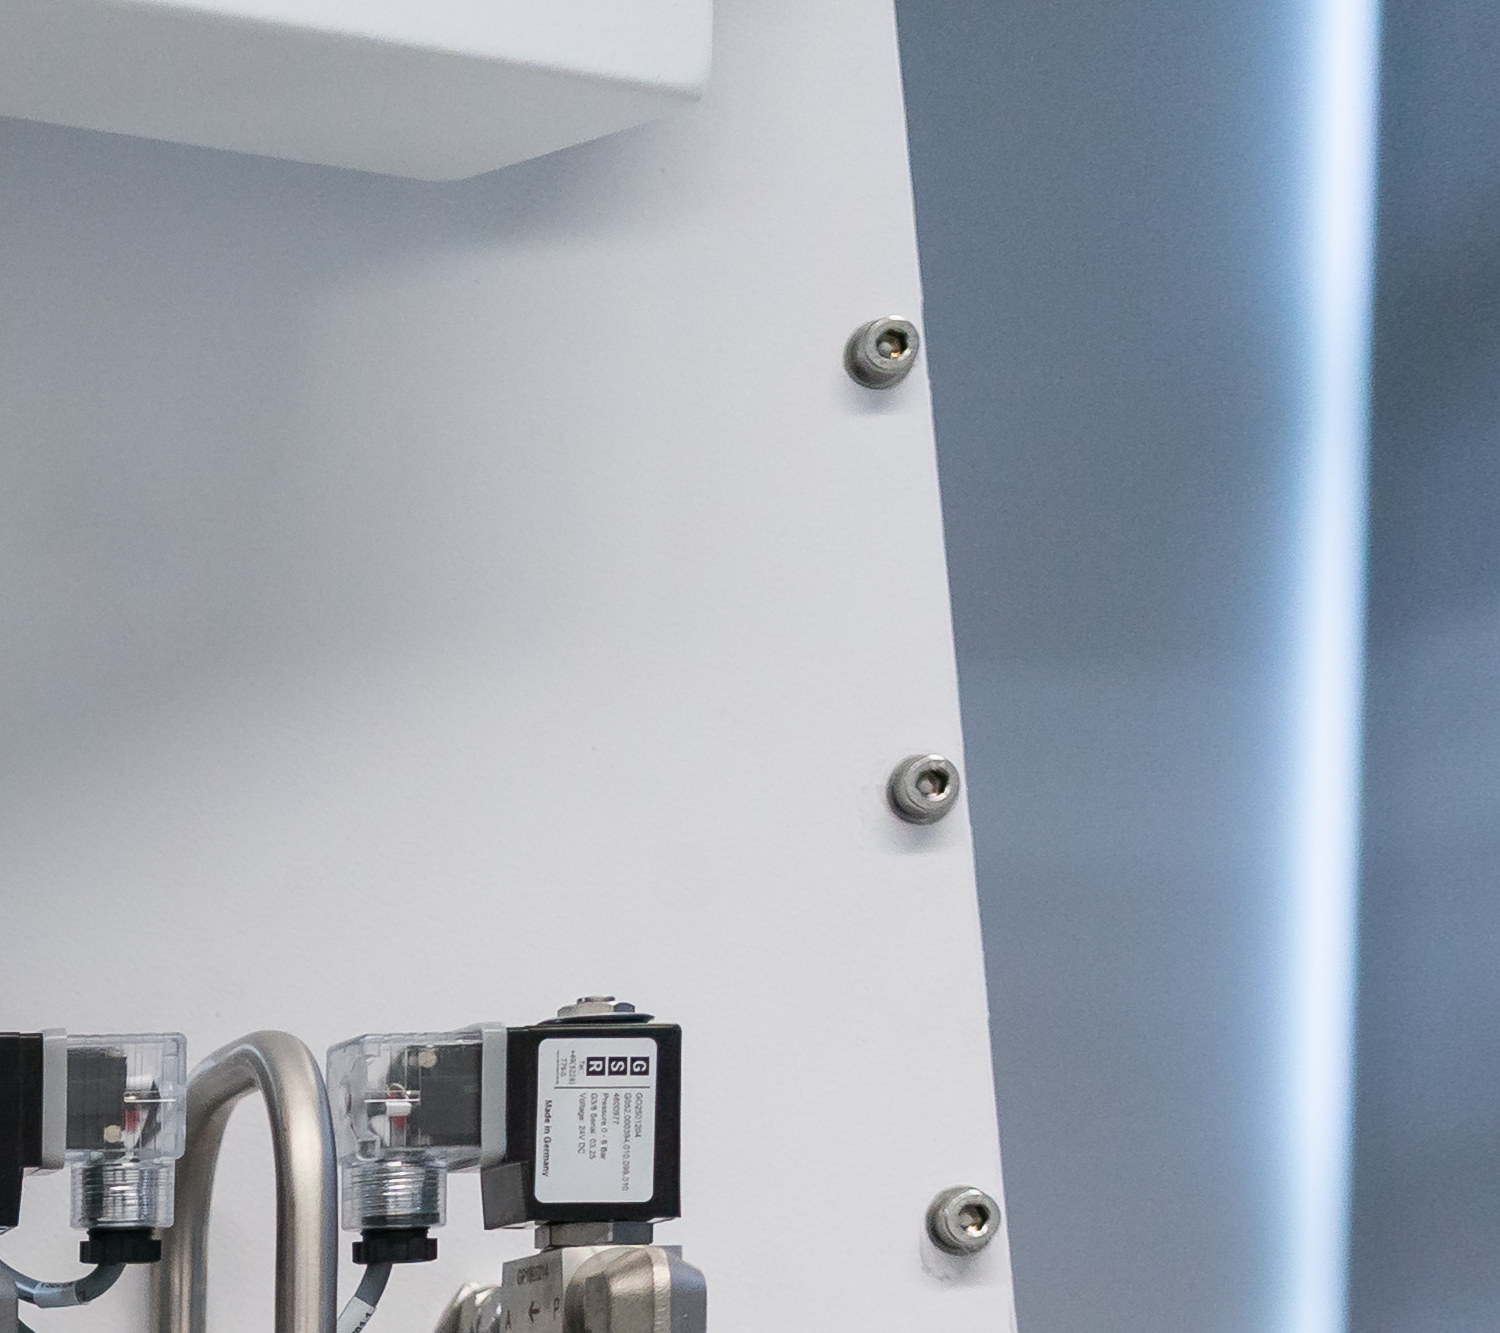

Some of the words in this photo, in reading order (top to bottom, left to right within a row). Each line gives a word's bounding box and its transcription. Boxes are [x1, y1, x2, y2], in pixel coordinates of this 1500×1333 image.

[544, 1100, 552, 1123] Made
[544, 1126, 552, 1134] in
[542, 1136, 552, 1177] Germany
